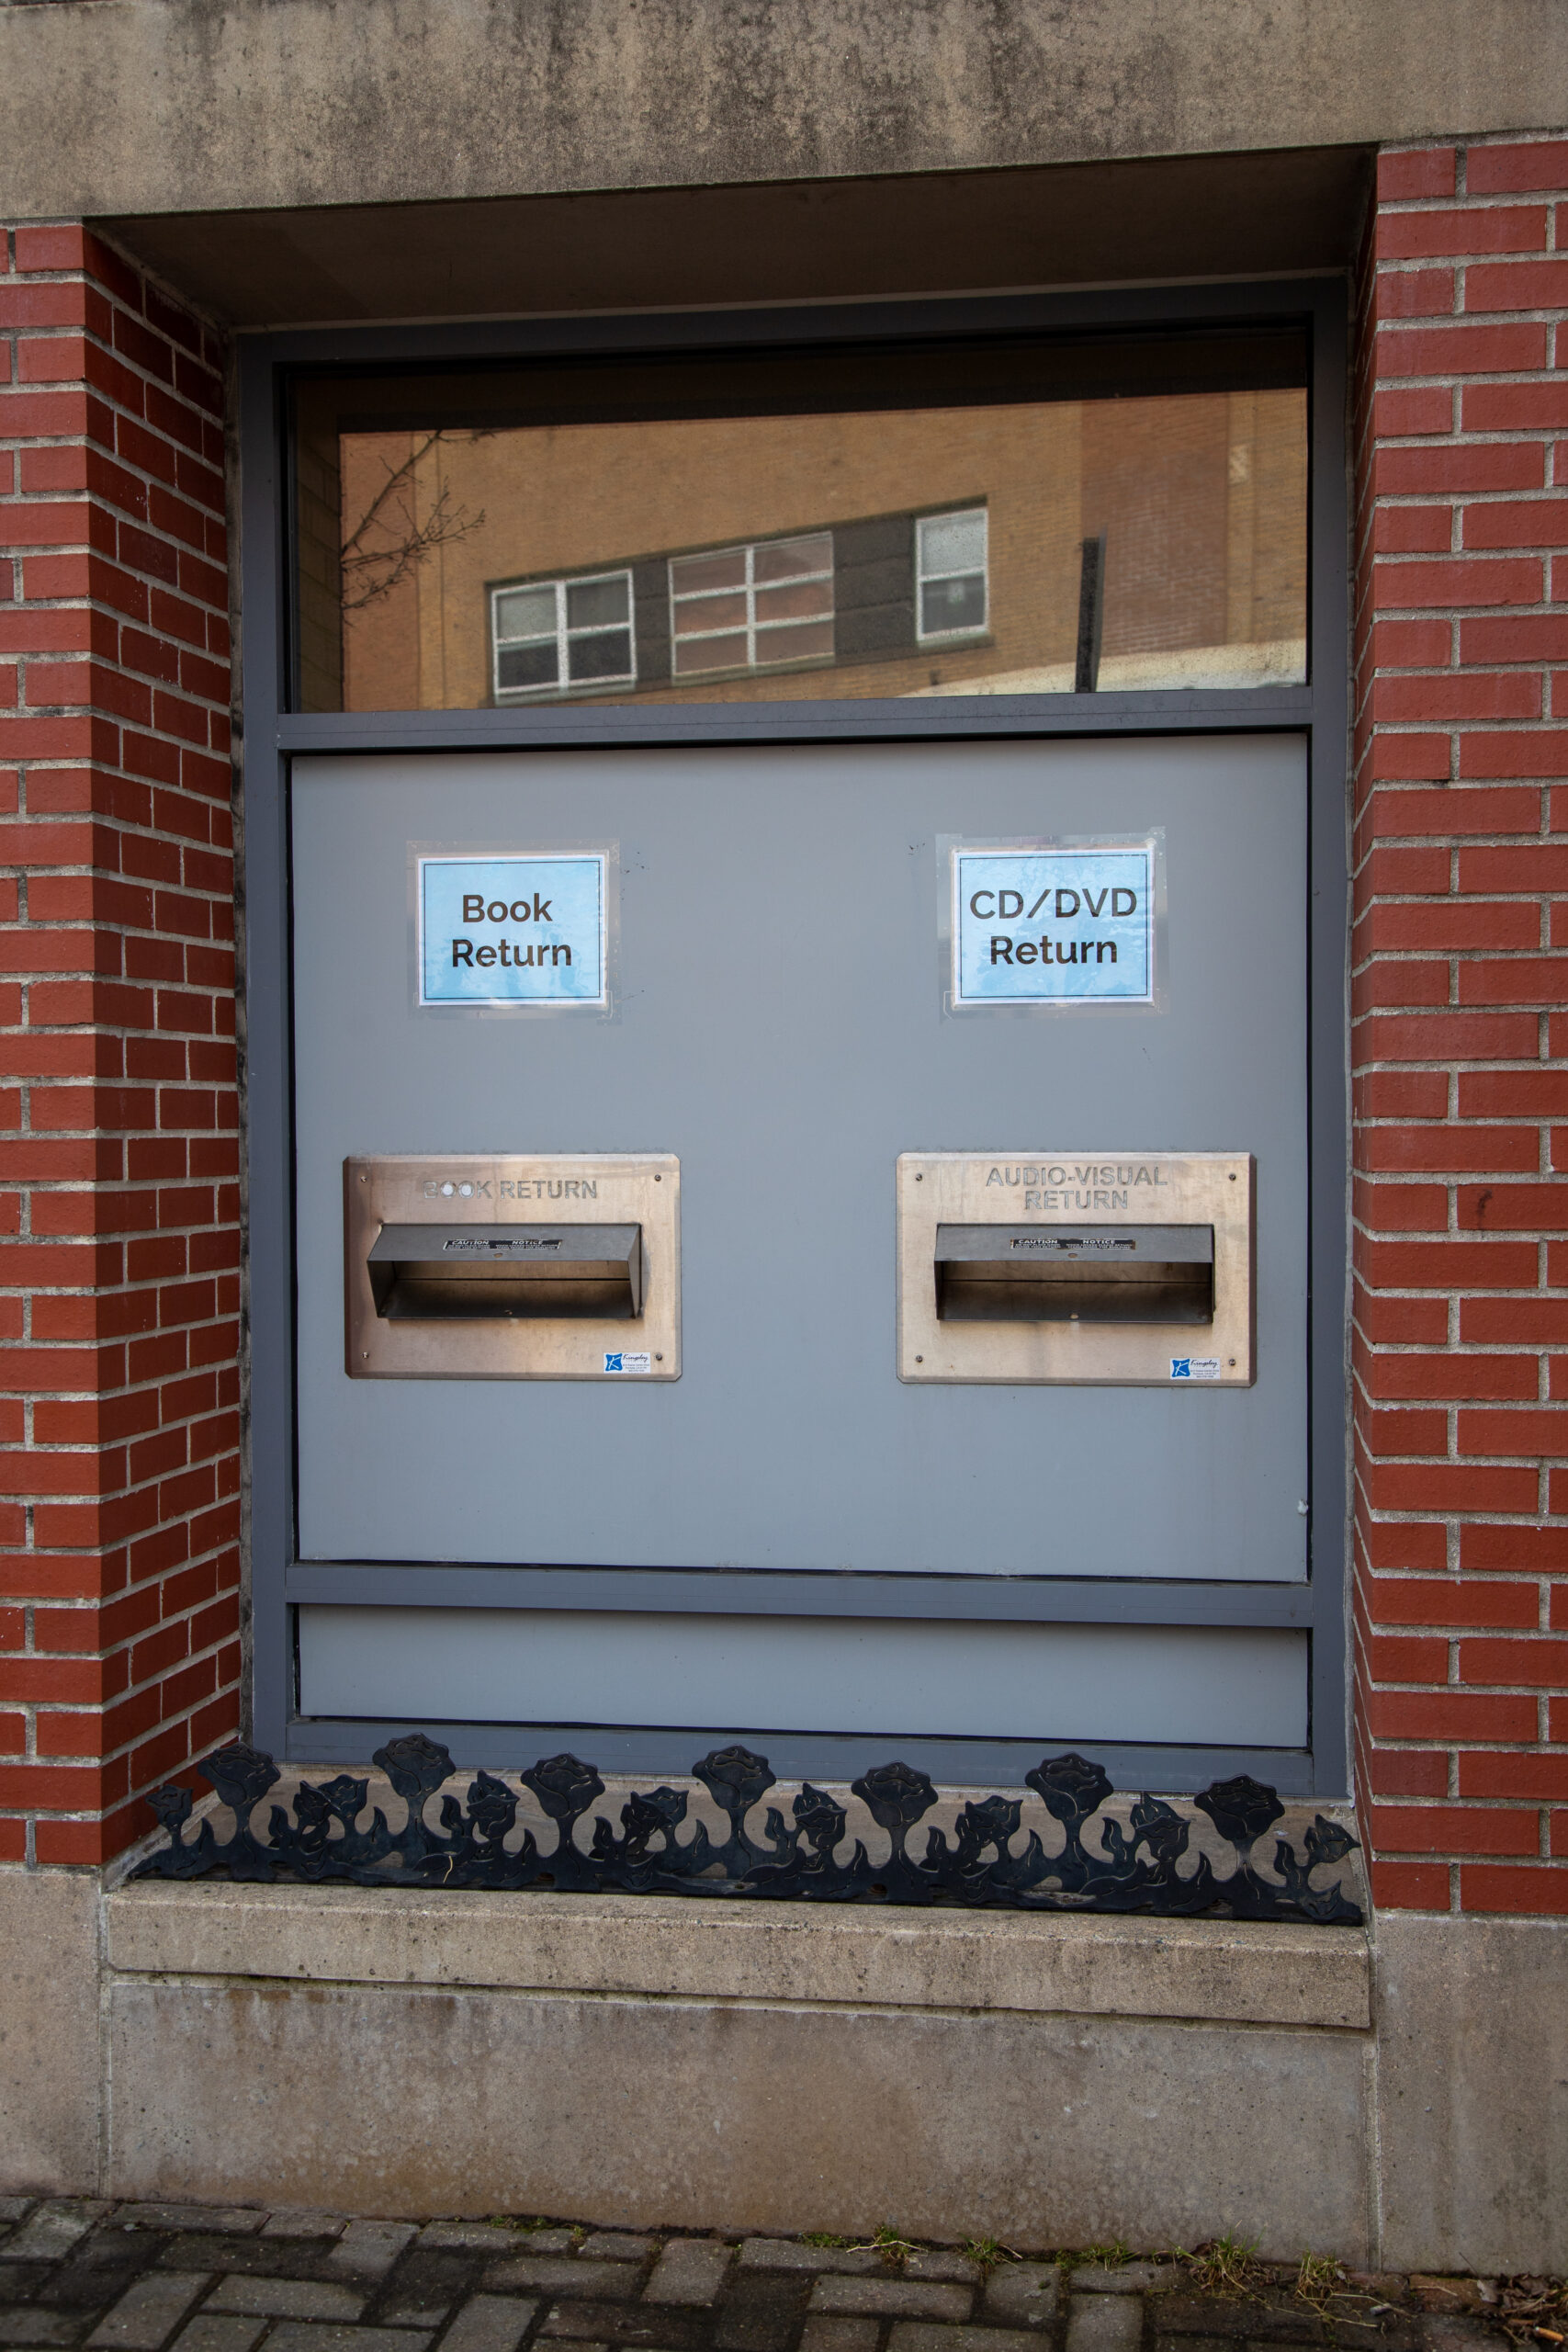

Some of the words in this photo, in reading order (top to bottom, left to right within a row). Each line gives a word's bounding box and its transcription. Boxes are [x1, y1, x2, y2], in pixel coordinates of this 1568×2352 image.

[462, 892, 553, 923] Book
[969, 888, 1137, 920] CD/DVD
[451, 938, 572, 968] Return
[990, 935, 1118, 966] Return
[423, 1180, 493, 1200] BOOK
[500, 1180, 599, 1200] RETURN
[986, 1166, 1168, 1188] AUDIO-VISUAL
[1024, 1190, 1128, 1211] RETURN
